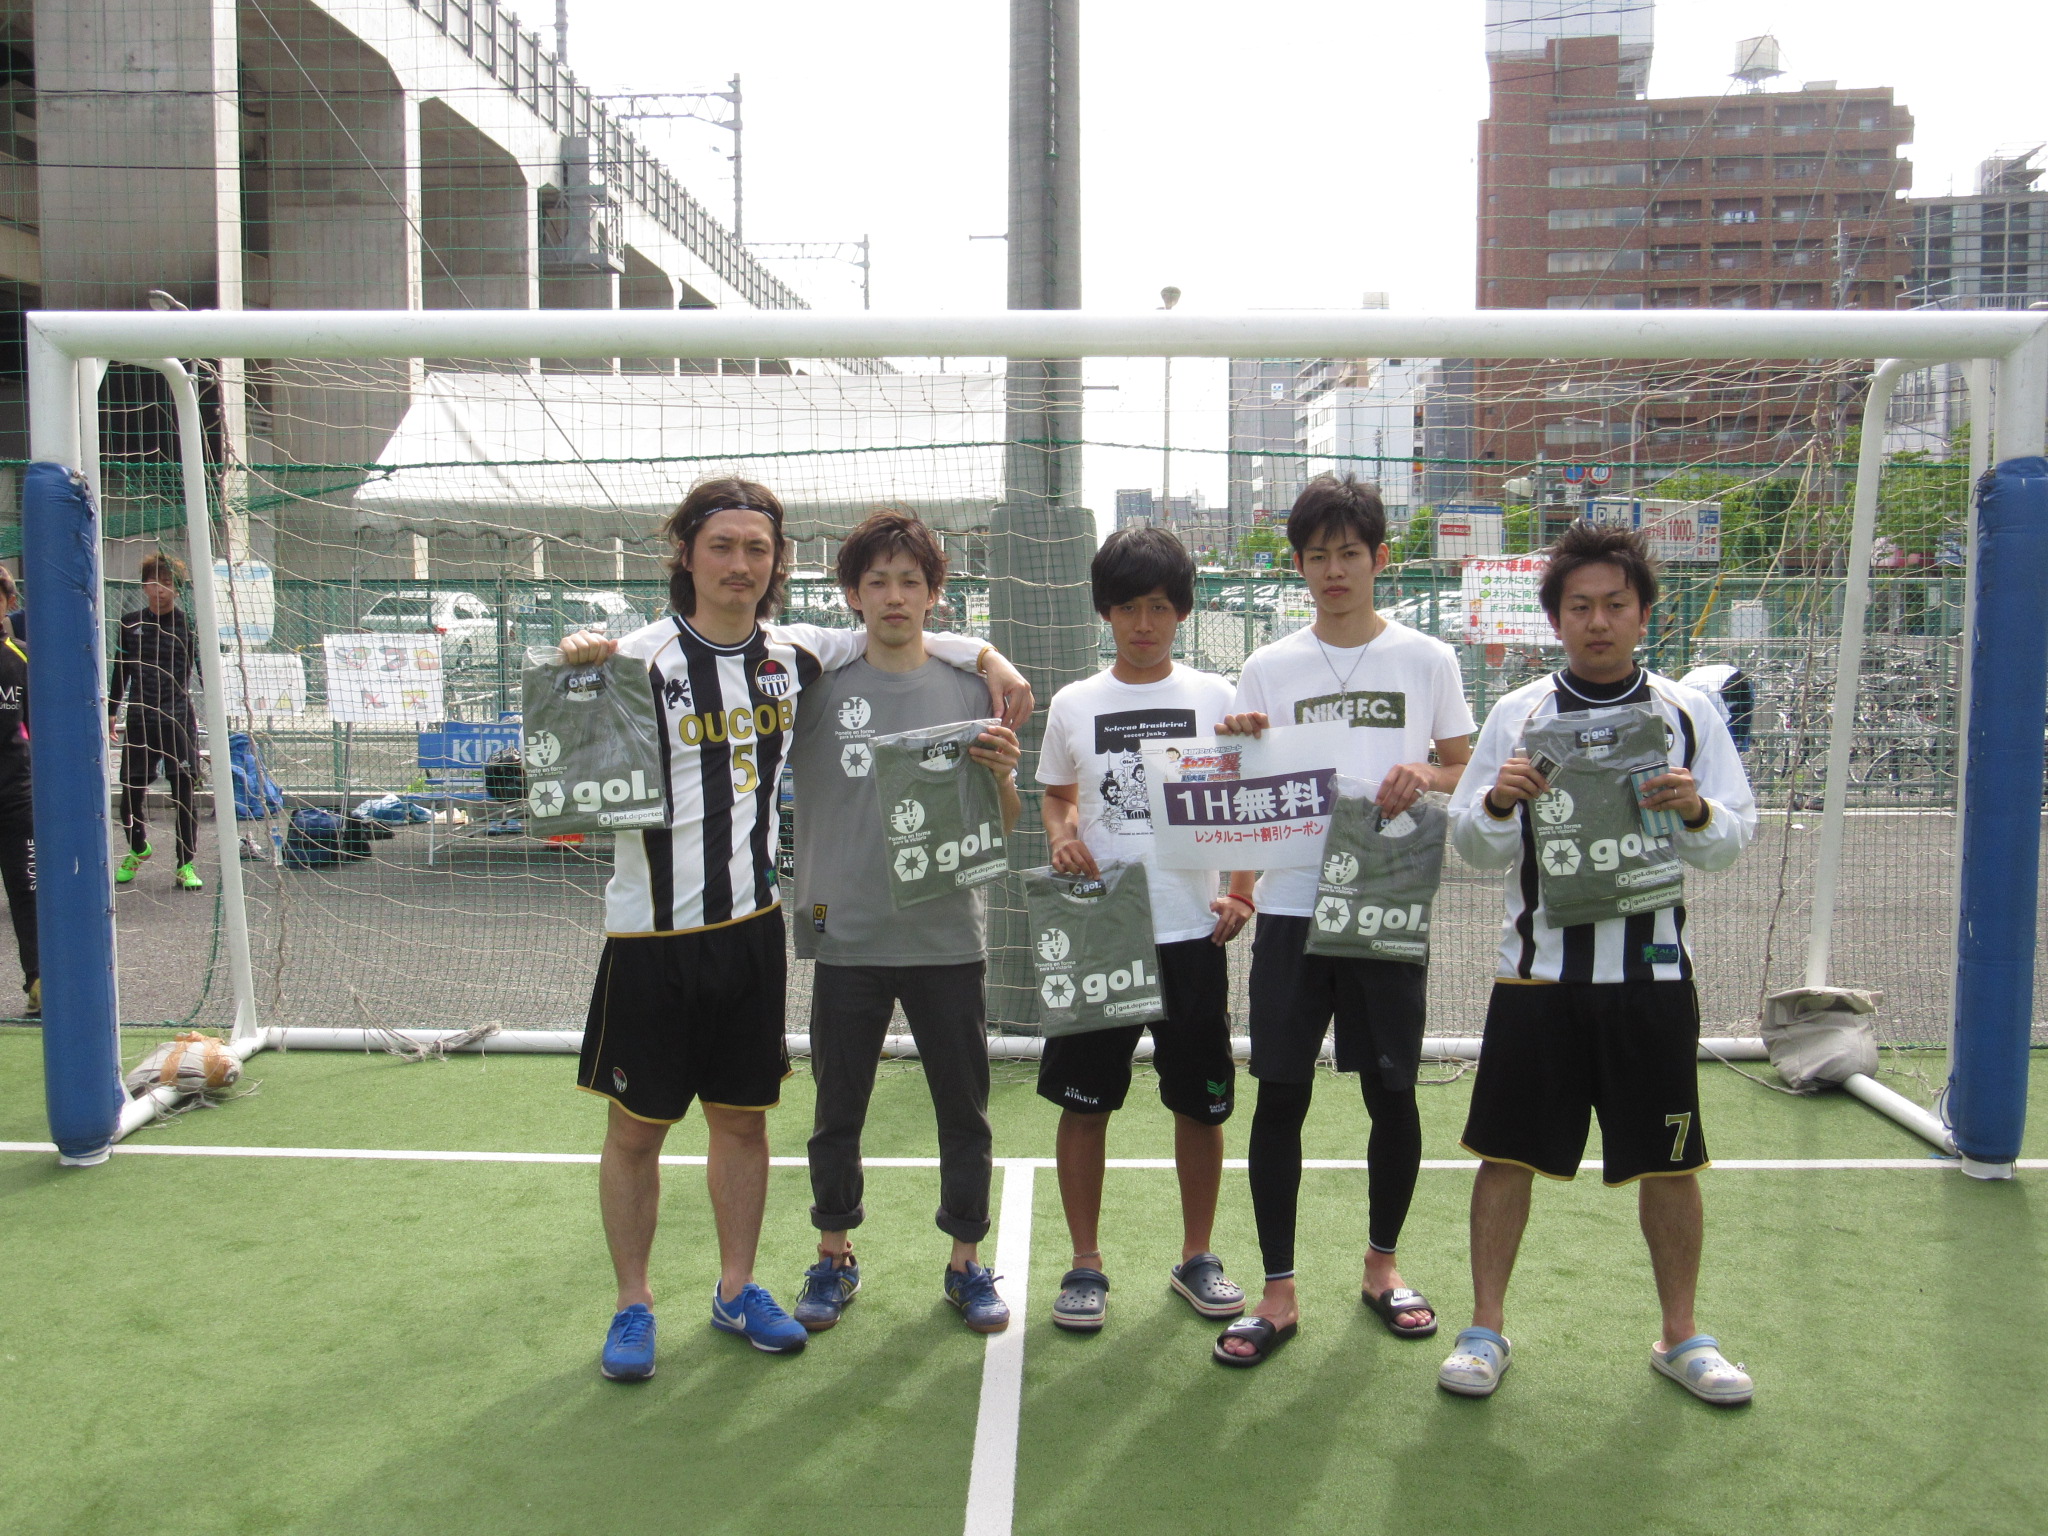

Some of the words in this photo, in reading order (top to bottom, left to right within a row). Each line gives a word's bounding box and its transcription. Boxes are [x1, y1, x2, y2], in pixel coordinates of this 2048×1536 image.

[761, 674, 785, 682] OUCOB
[0, 686, 23, 702] ME
[679, 699, 794, 746] OUCOB
[1302, 700, 1356, 724] NIKE
[1357, 698, 1397, 720] F.C.
[1591, 727, 1613, 740] gol.
[733, 744, 757, 793] 5
[572, 770, 659, 812] gol.
[1177, 778, 1325, 822] 1H無料
[935, 822, 1002, 872] gol.
[1195, 821, 1324, 844] レンタルコート割引クーポン
[1631, 863, 1679, 881] gol.deportes
[1083, 881, 1101, 893] gol.
[1357, 904, 1428, 937] gol.
[1082, 959, 1156, 1003] gol.
[1065, 1090, 1098, 1105] ATHLETA
[1665, 1112, 1692, 1161] 7
